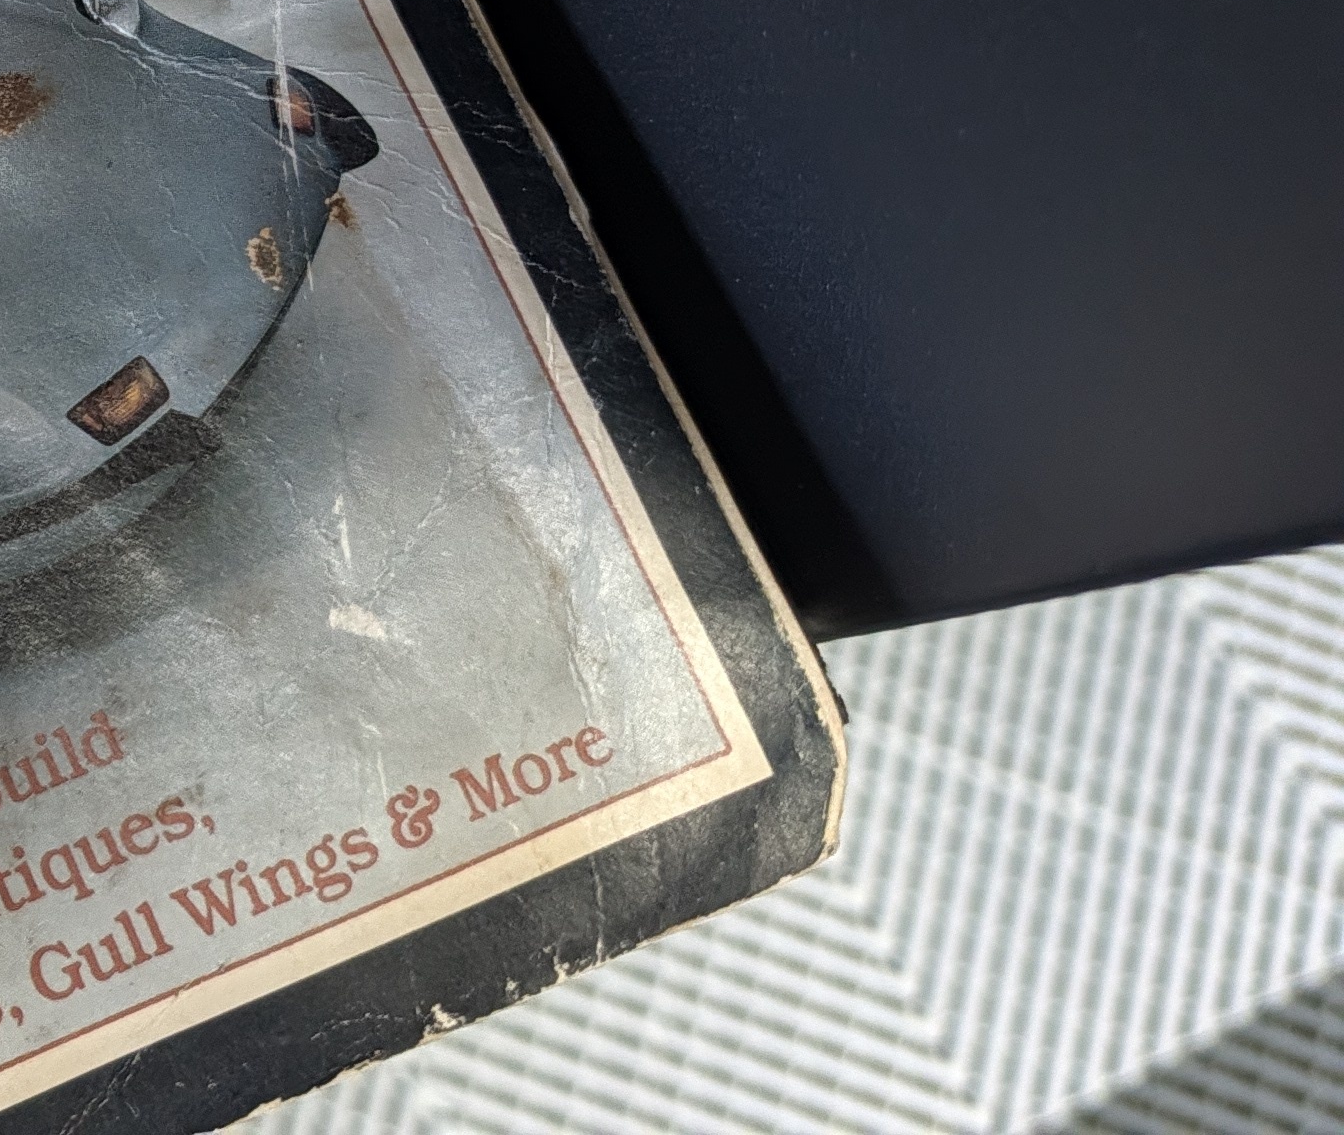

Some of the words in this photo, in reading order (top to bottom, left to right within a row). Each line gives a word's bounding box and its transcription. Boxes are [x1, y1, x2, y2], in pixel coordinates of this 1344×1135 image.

[29, 902, 173, 1002] Gull
[170, 821, 380, 938] Wings
[385, 782, 441, 850] &
[449, 724, 615, 822] More
